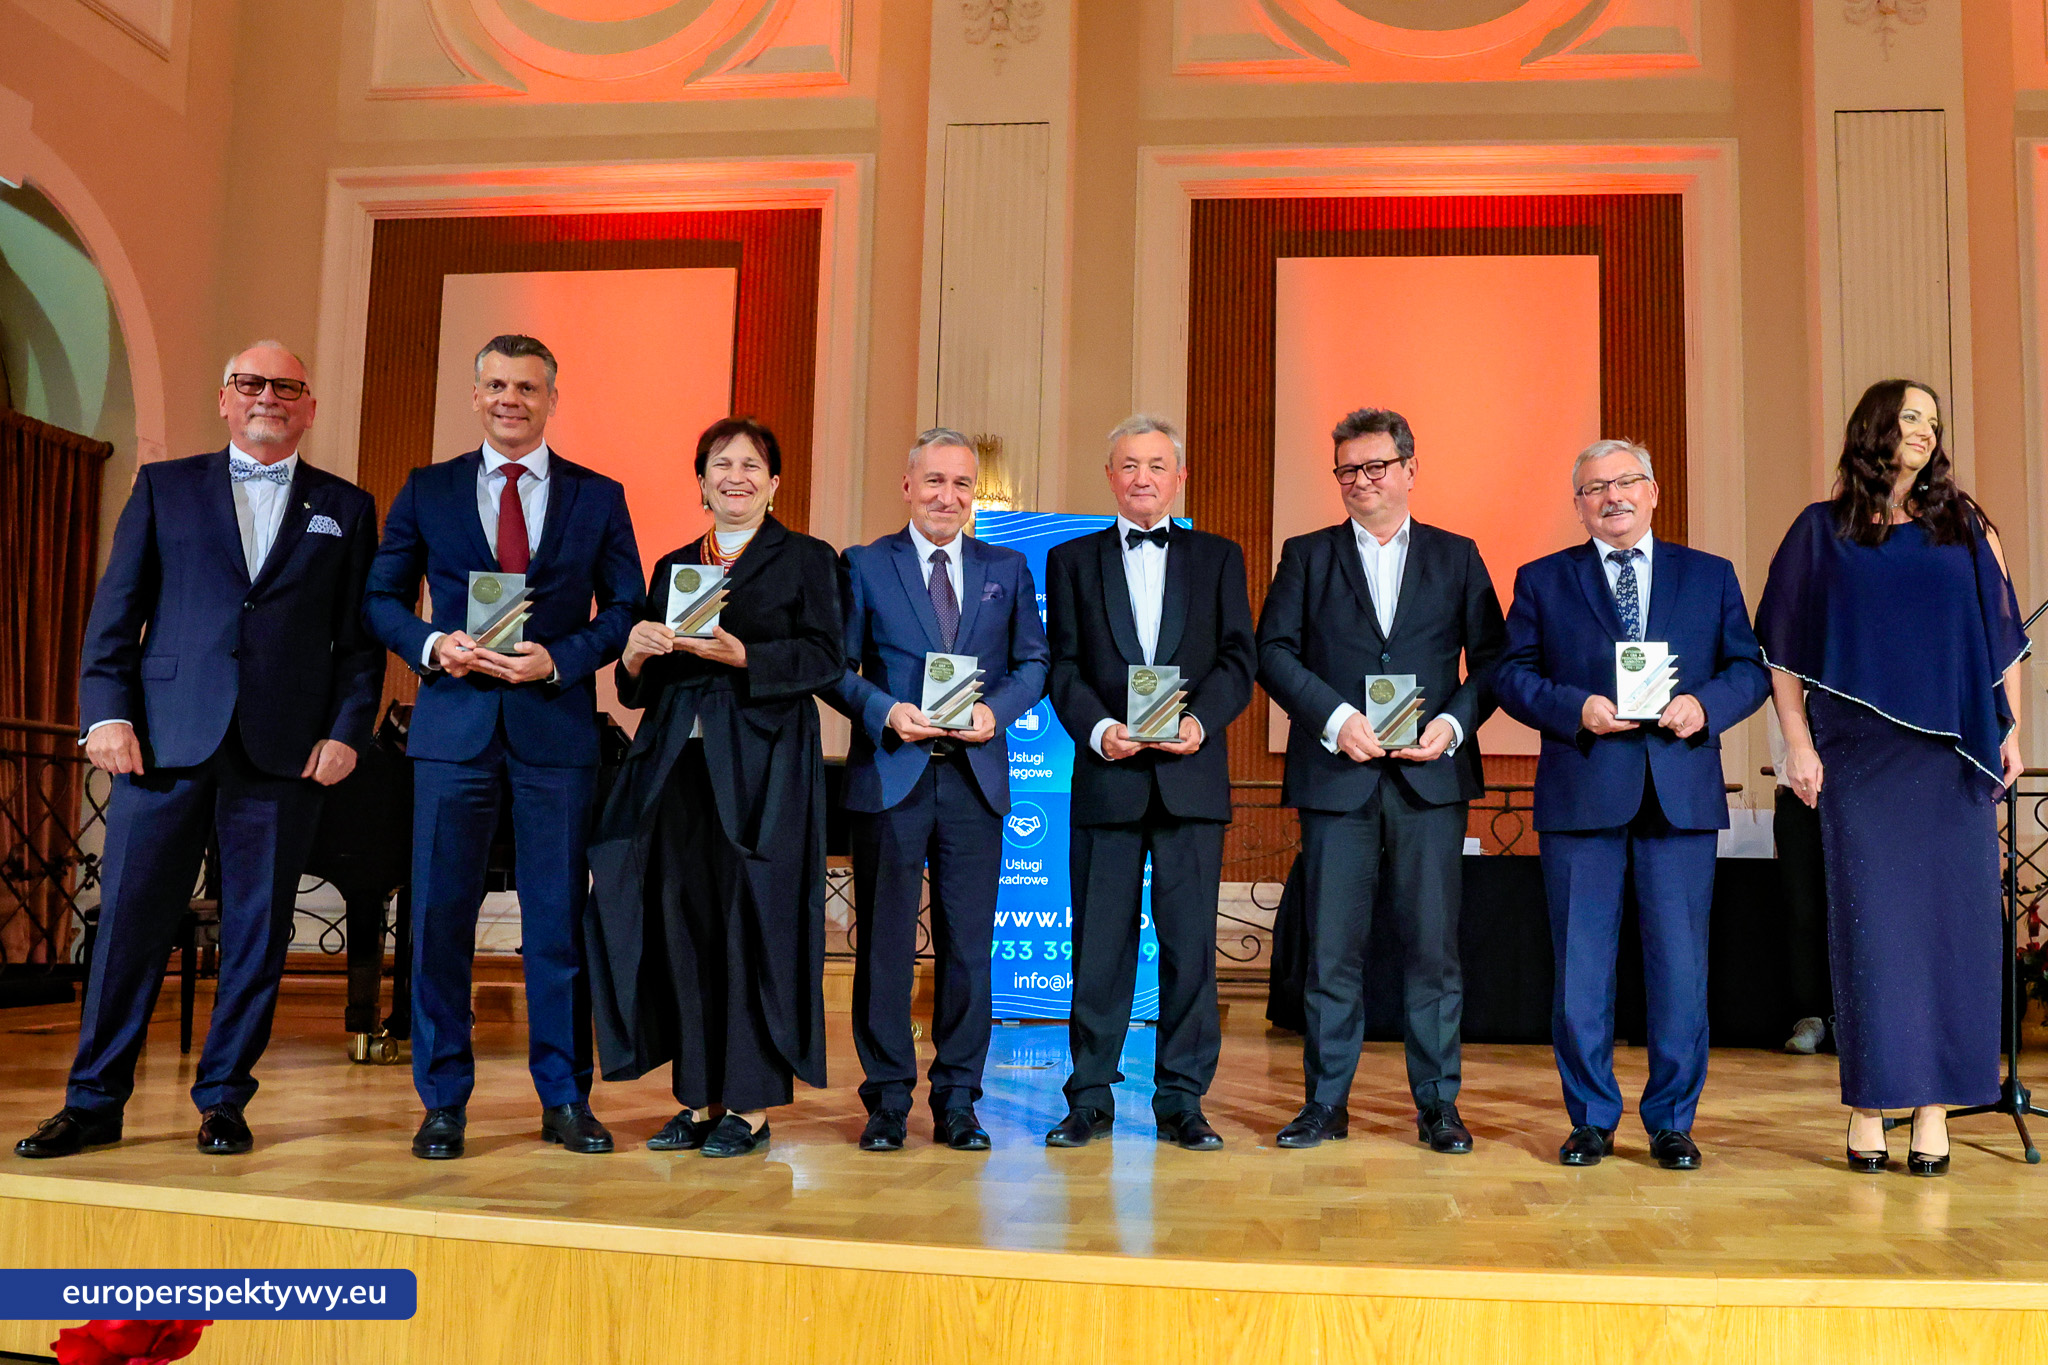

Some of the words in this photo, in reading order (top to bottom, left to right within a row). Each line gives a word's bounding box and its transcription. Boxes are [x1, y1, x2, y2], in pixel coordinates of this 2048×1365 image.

[1008, 751, 1044, 765] Usługi
[1009, 766, 1053, 780] ięgowe
[1005, 859, 1042, 872] Usługi
[999, 874, 1048, 885] kadrowe
